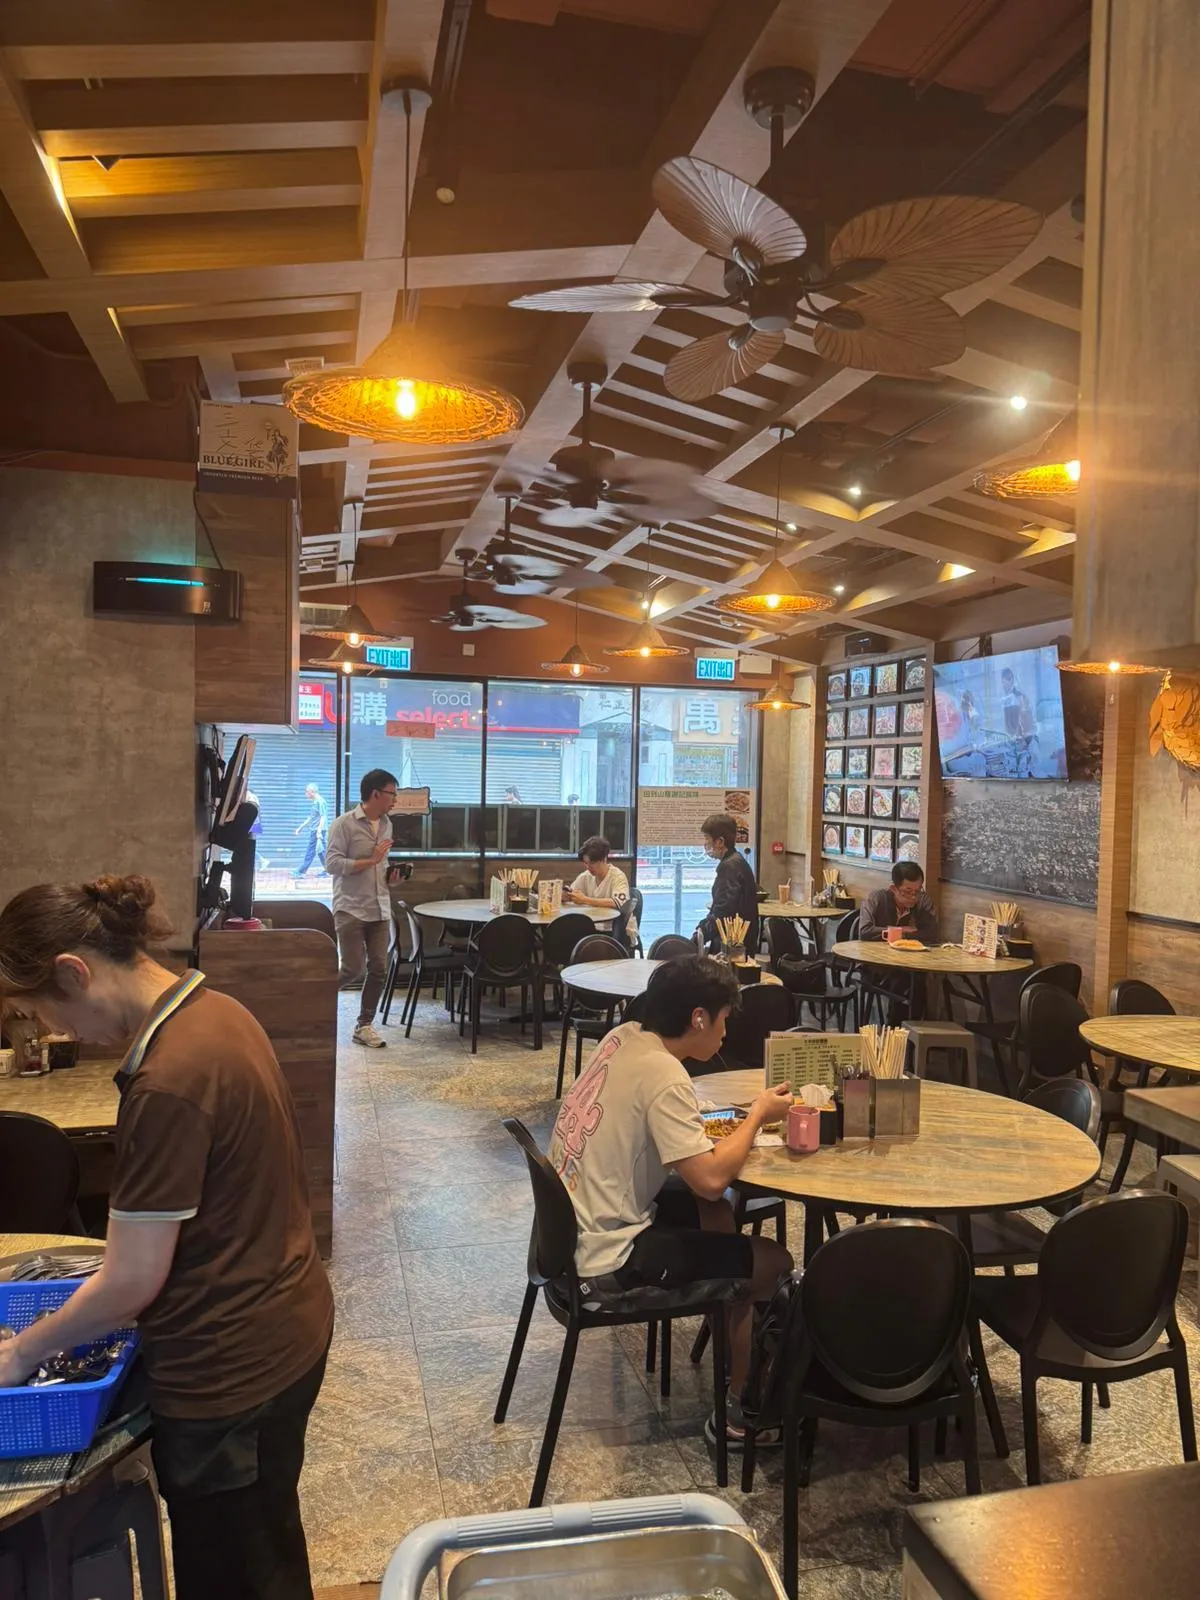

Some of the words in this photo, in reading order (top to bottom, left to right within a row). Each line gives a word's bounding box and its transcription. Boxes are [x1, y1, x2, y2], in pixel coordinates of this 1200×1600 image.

[369, 649, 389, 667] EXIT
[389, 650, 408, 669] 出口
[699, 660, 718, 677] EXIT
[717, 661, 733, 679] 出口
[432, 690, 472, 706] food
[352, 692, 388, 726] 購
[396, 706, 472, 731] select
